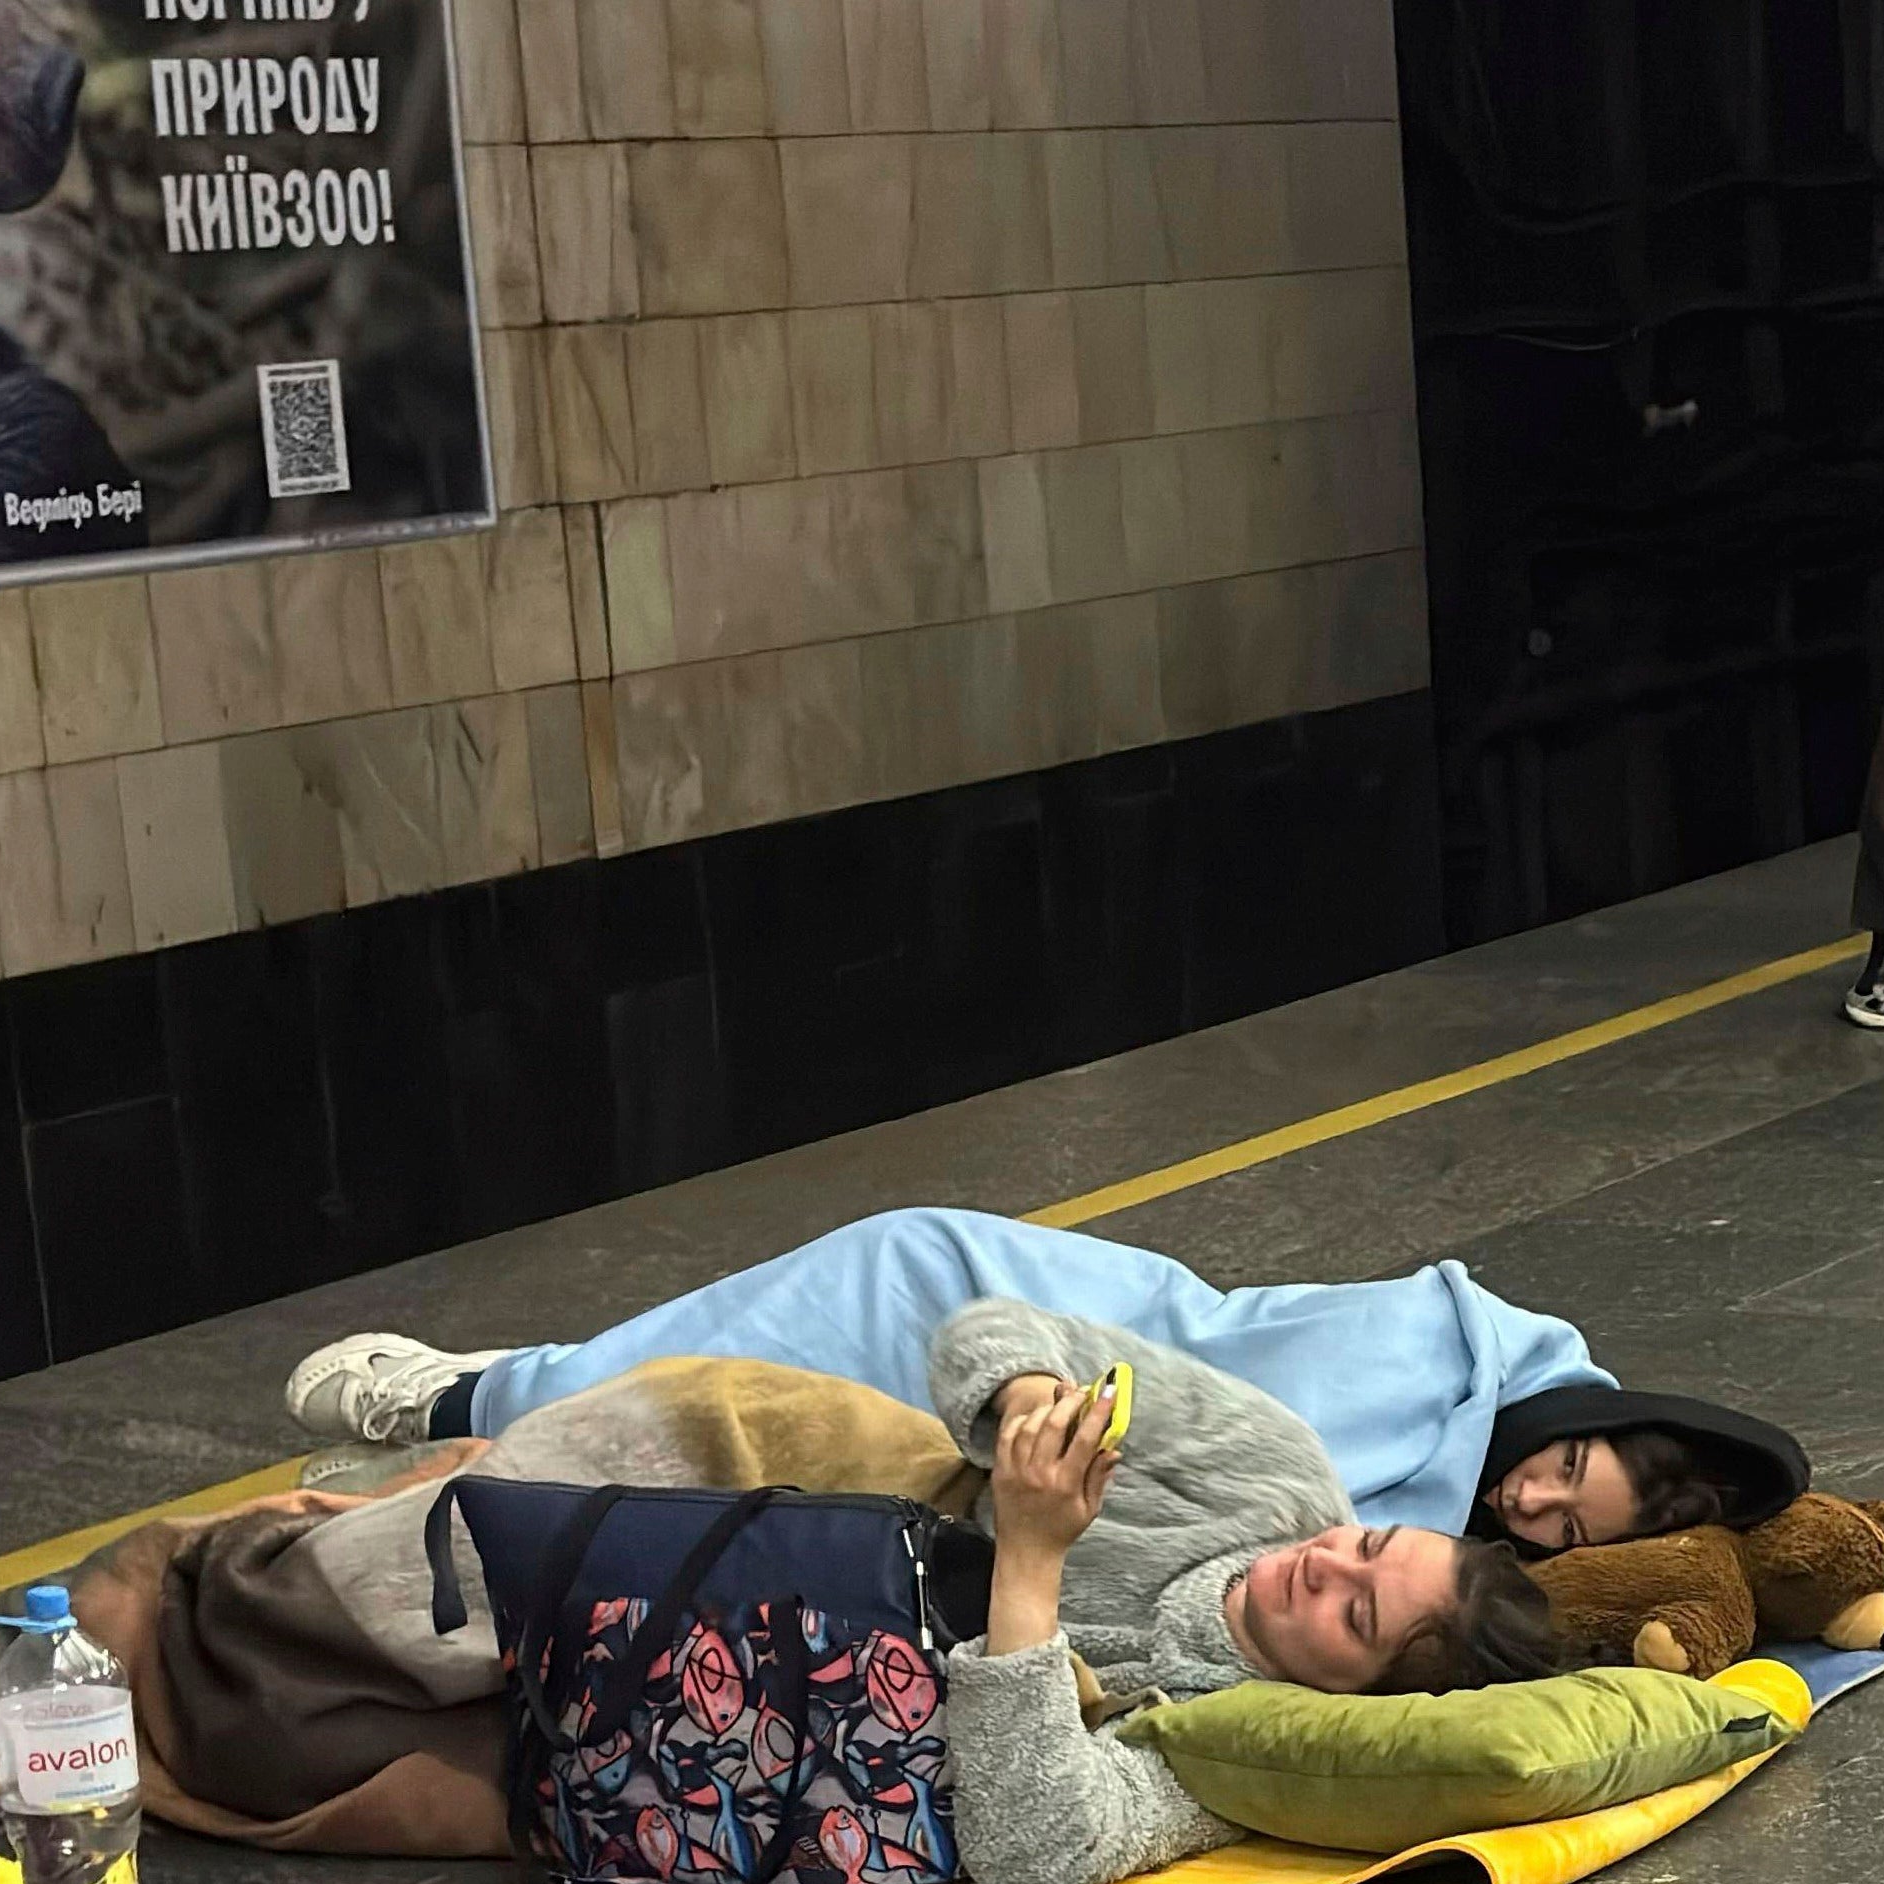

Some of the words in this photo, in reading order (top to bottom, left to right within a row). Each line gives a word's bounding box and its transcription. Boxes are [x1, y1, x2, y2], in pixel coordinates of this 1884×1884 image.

[150, 56, 379, 136] ПРИРОДУ
[161, 154, 396, 253] КИЇВЗОО!
[96, 480, 142, 523] Бері
[28, 1738, 129, 1772] avalon
